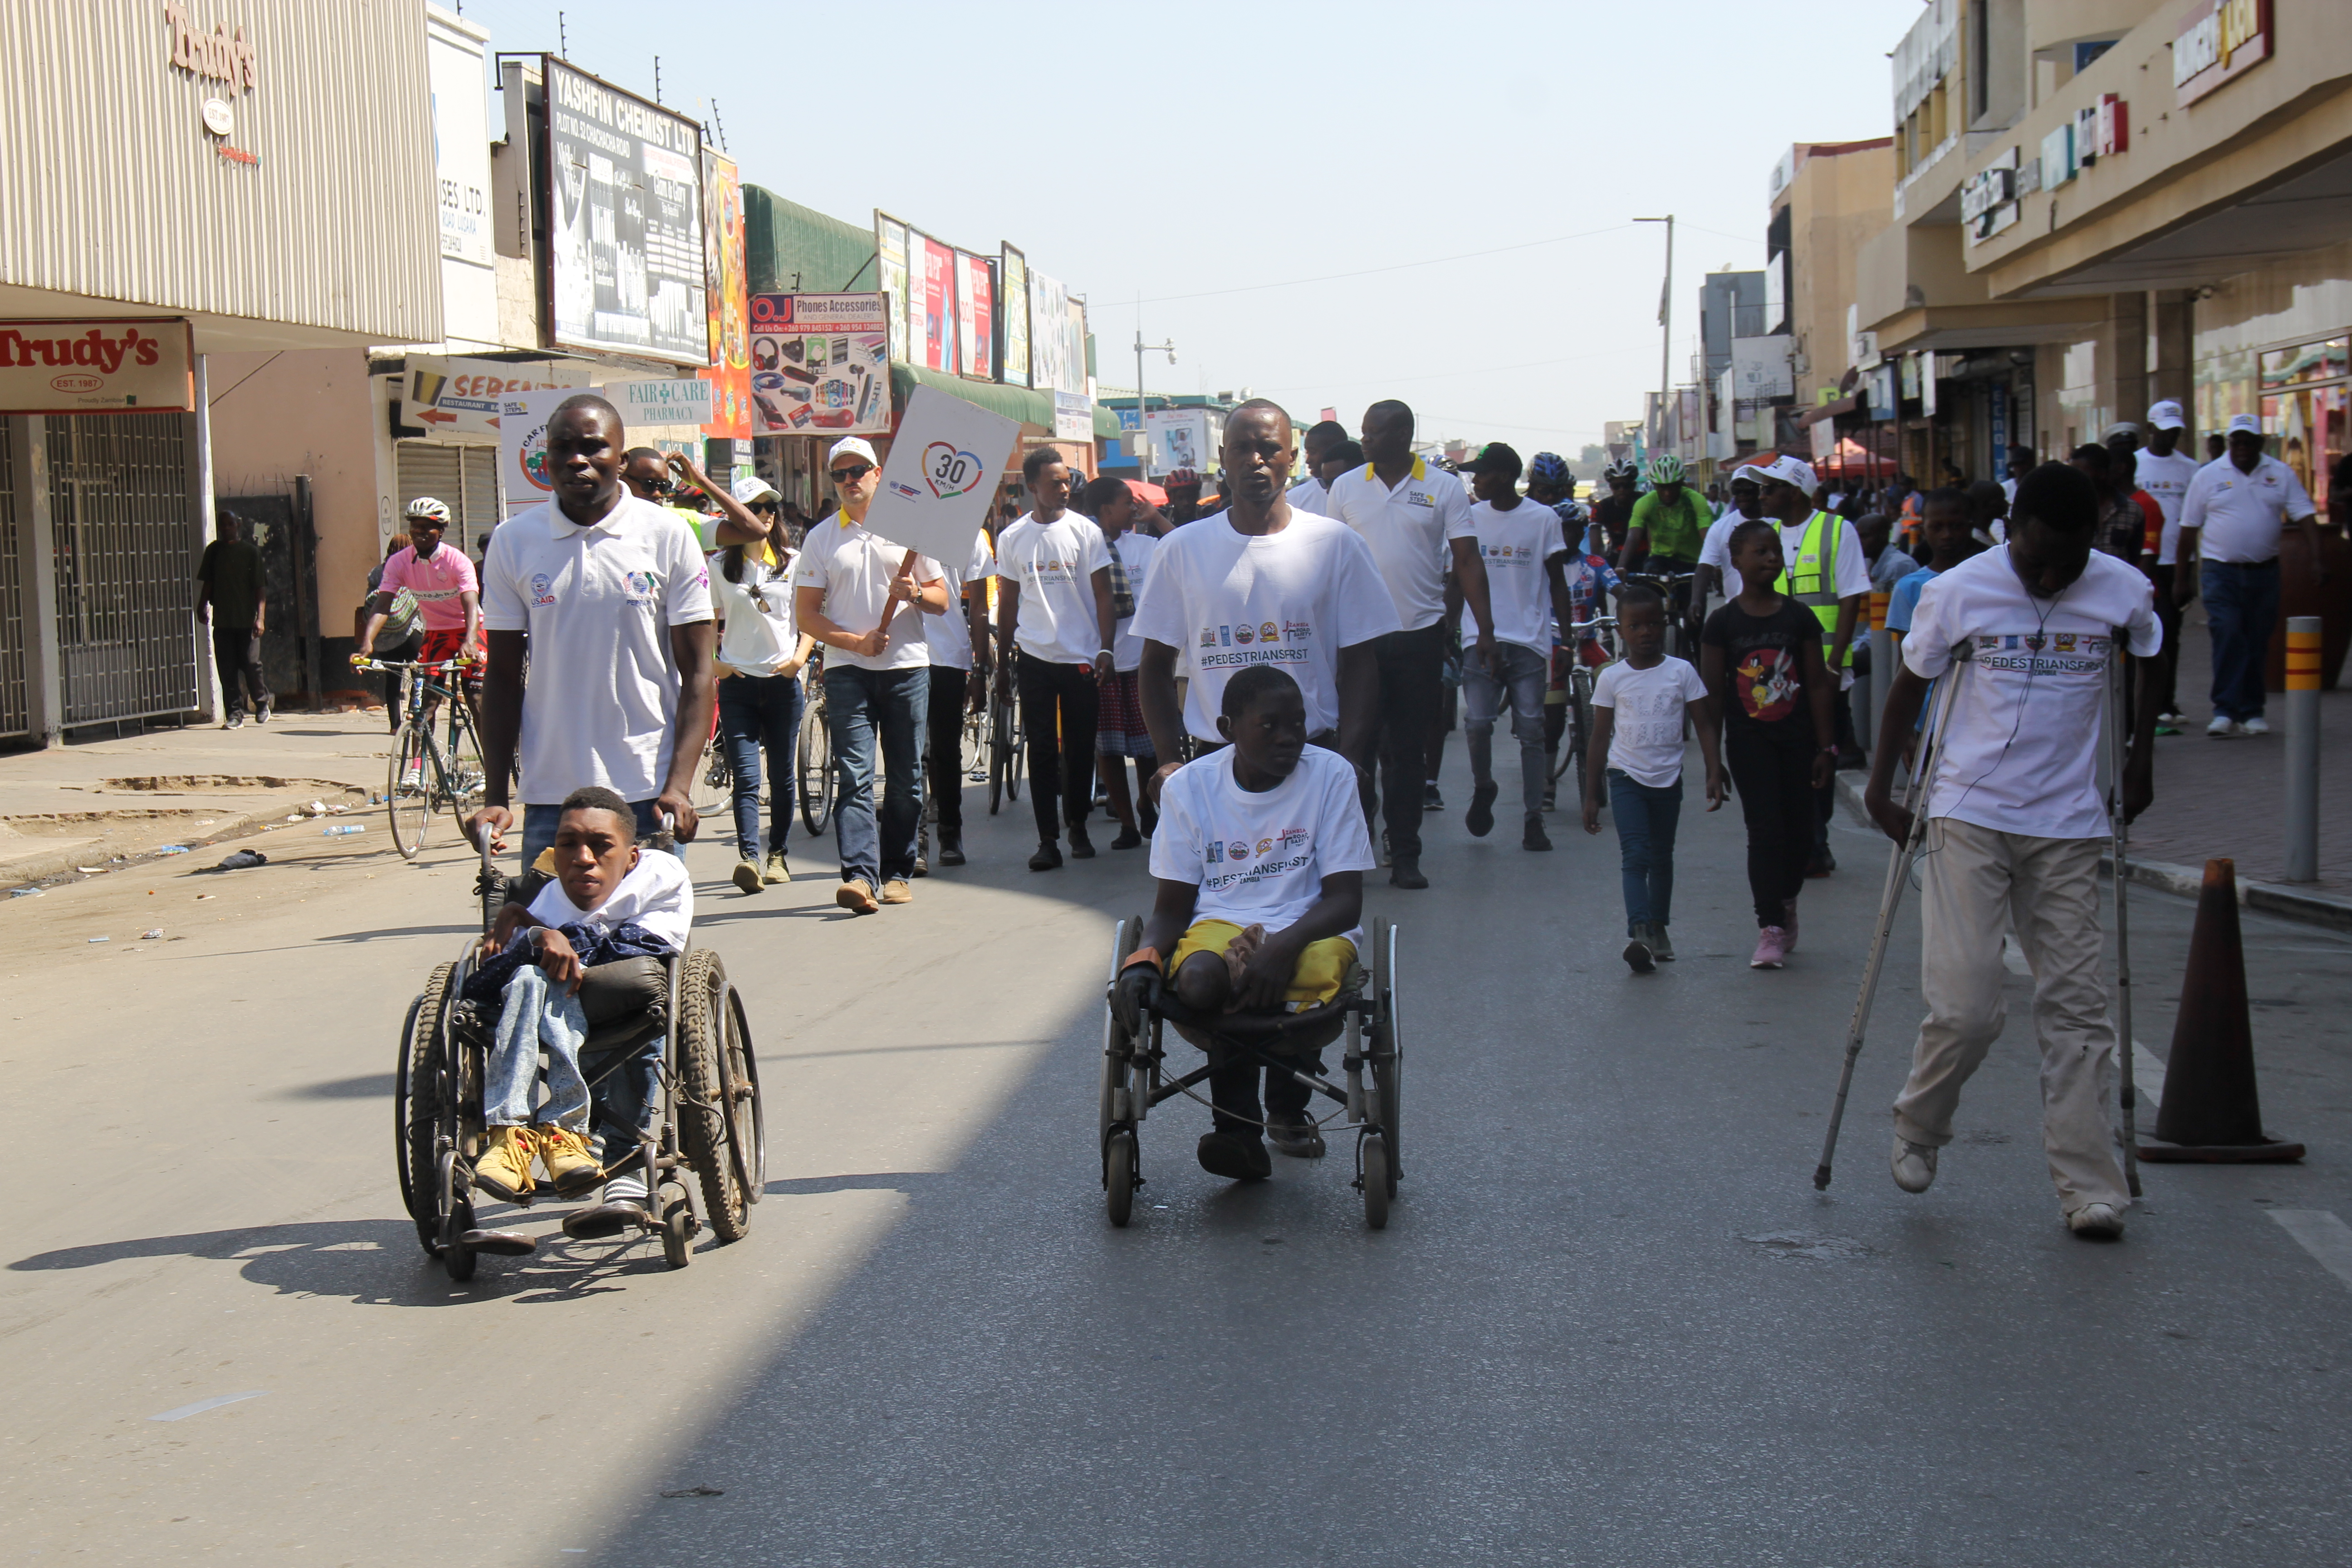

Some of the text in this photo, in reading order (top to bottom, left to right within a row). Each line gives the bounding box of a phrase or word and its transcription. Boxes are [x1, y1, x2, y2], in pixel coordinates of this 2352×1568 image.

[168, 0, 256, 96] Trudy's
[554, 69, 696, 157] YASHFIN CHEMIST LTD
[557, 112, 570, 134] PLOT
[616, 137, 630, 158] ROAD
[752, 298, 791, 322] O.J
[797, 299, 881, 313] Phones Accessories
[0, 328, 159, 374] Trudy's
[629, 382, 708, 403] FAIR CARE
[442, 399, 485, 409] RESTAURANT
[644, 407, 693, 421] PHARMACY
[523, 429, 539, 447] CAR
[936, 454, 966, 484] 30
[935, 479, 955, 491] KM/H
[531, 595, 554, 606] USAID
[1240, 876, 1260, 884] ZAMBIA
